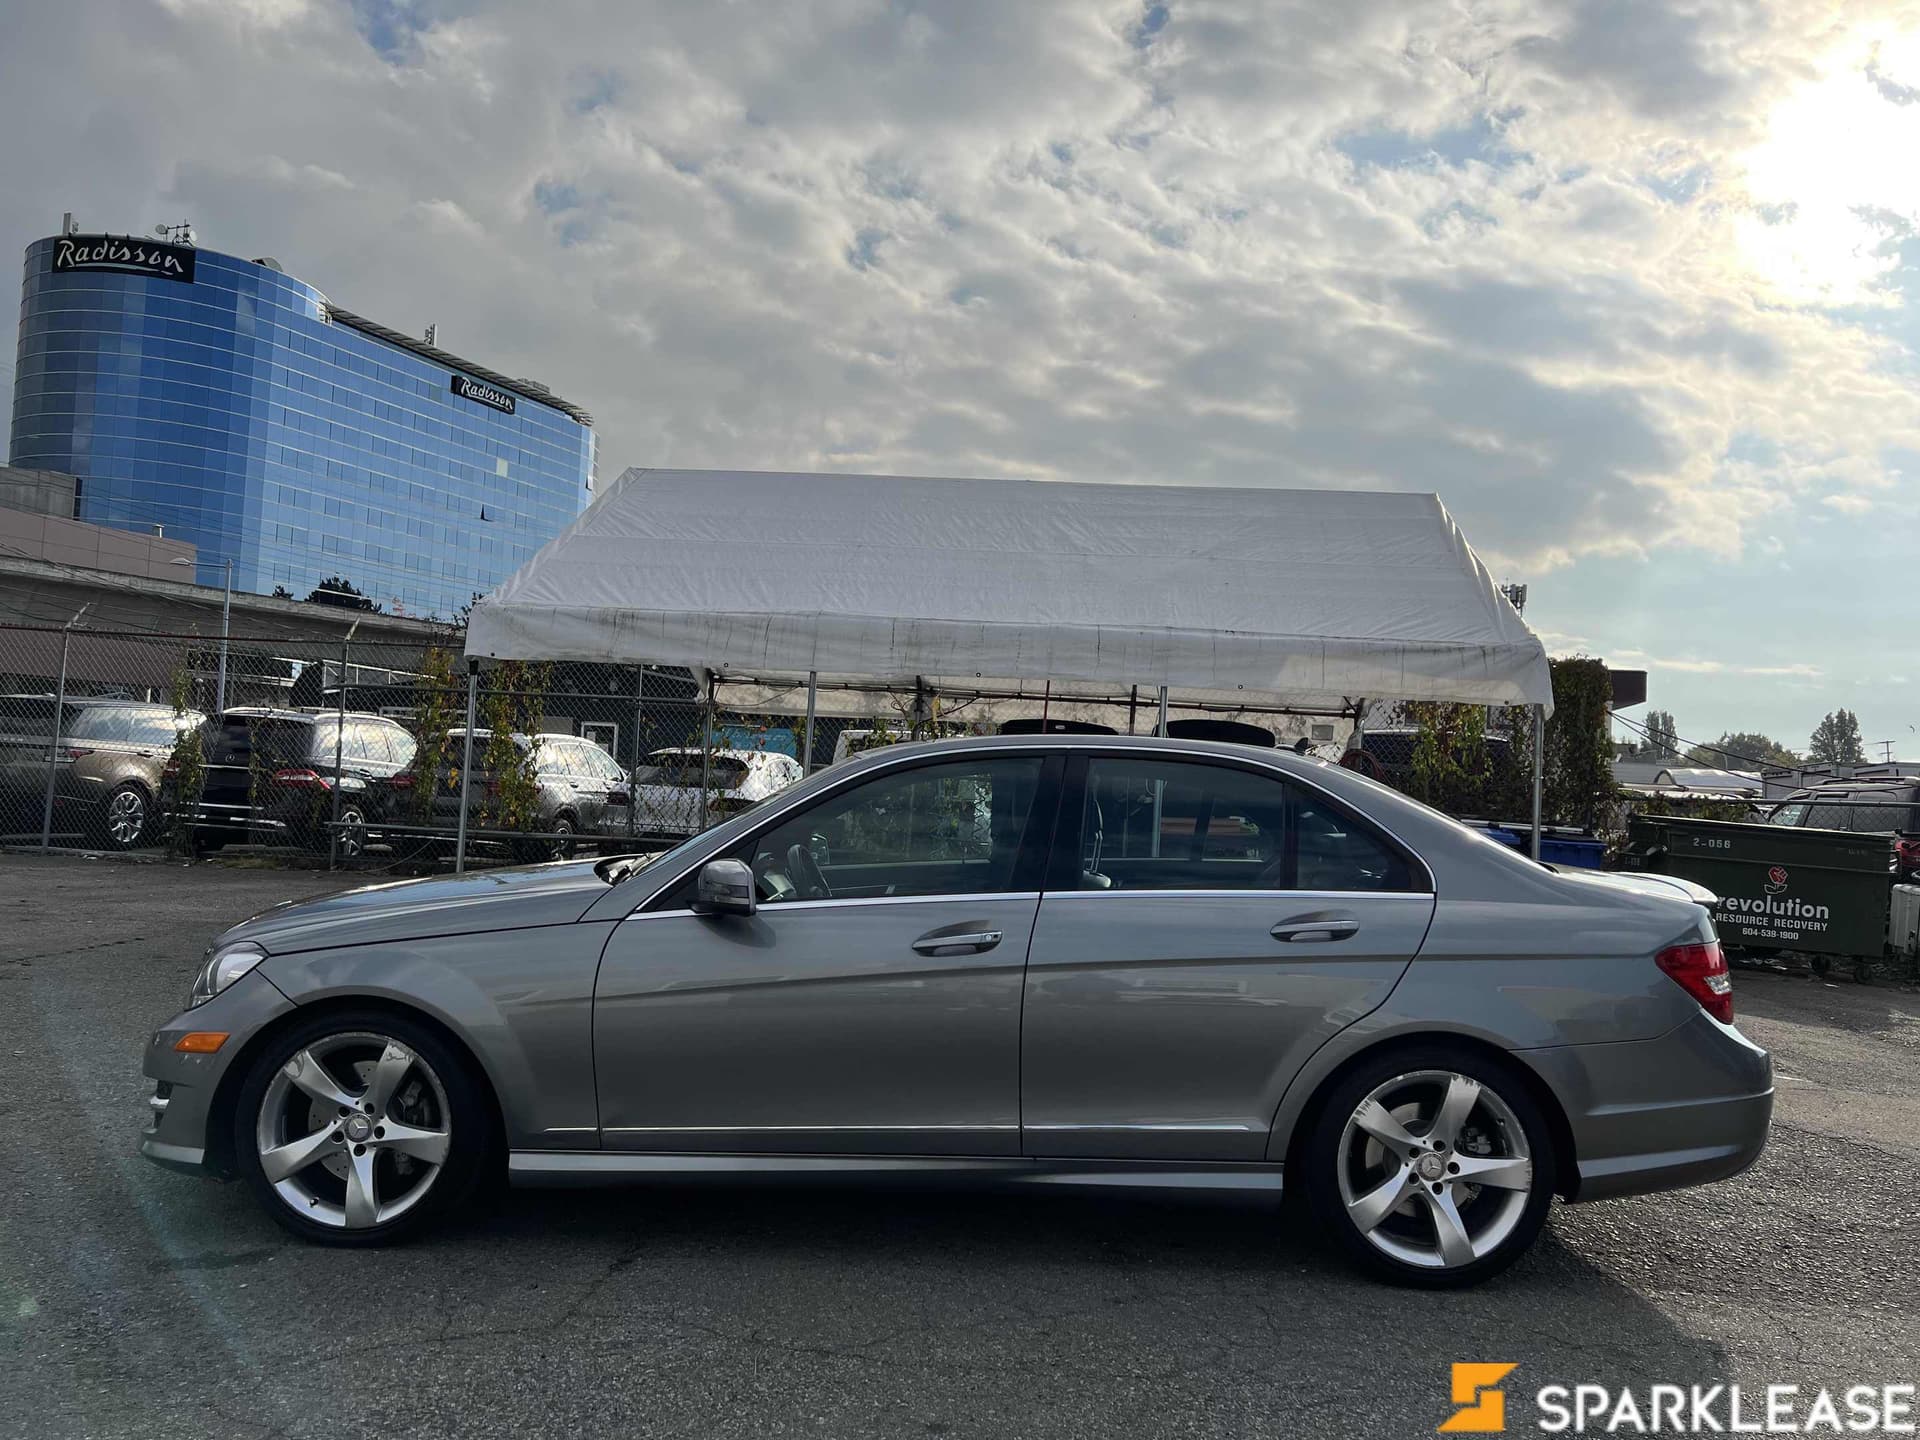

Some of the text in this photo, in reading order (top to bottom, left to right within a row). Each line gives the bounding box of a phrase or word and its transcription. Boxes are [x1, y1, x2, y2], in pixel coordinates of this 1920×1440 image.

[56, 240, 184, 275] Radisson
[460, 376, 513, 410] Radisson
[1717, 894, 1829, 919] revolution
[1715, 912, 1828, 932] RESOURCE RECOVERY
